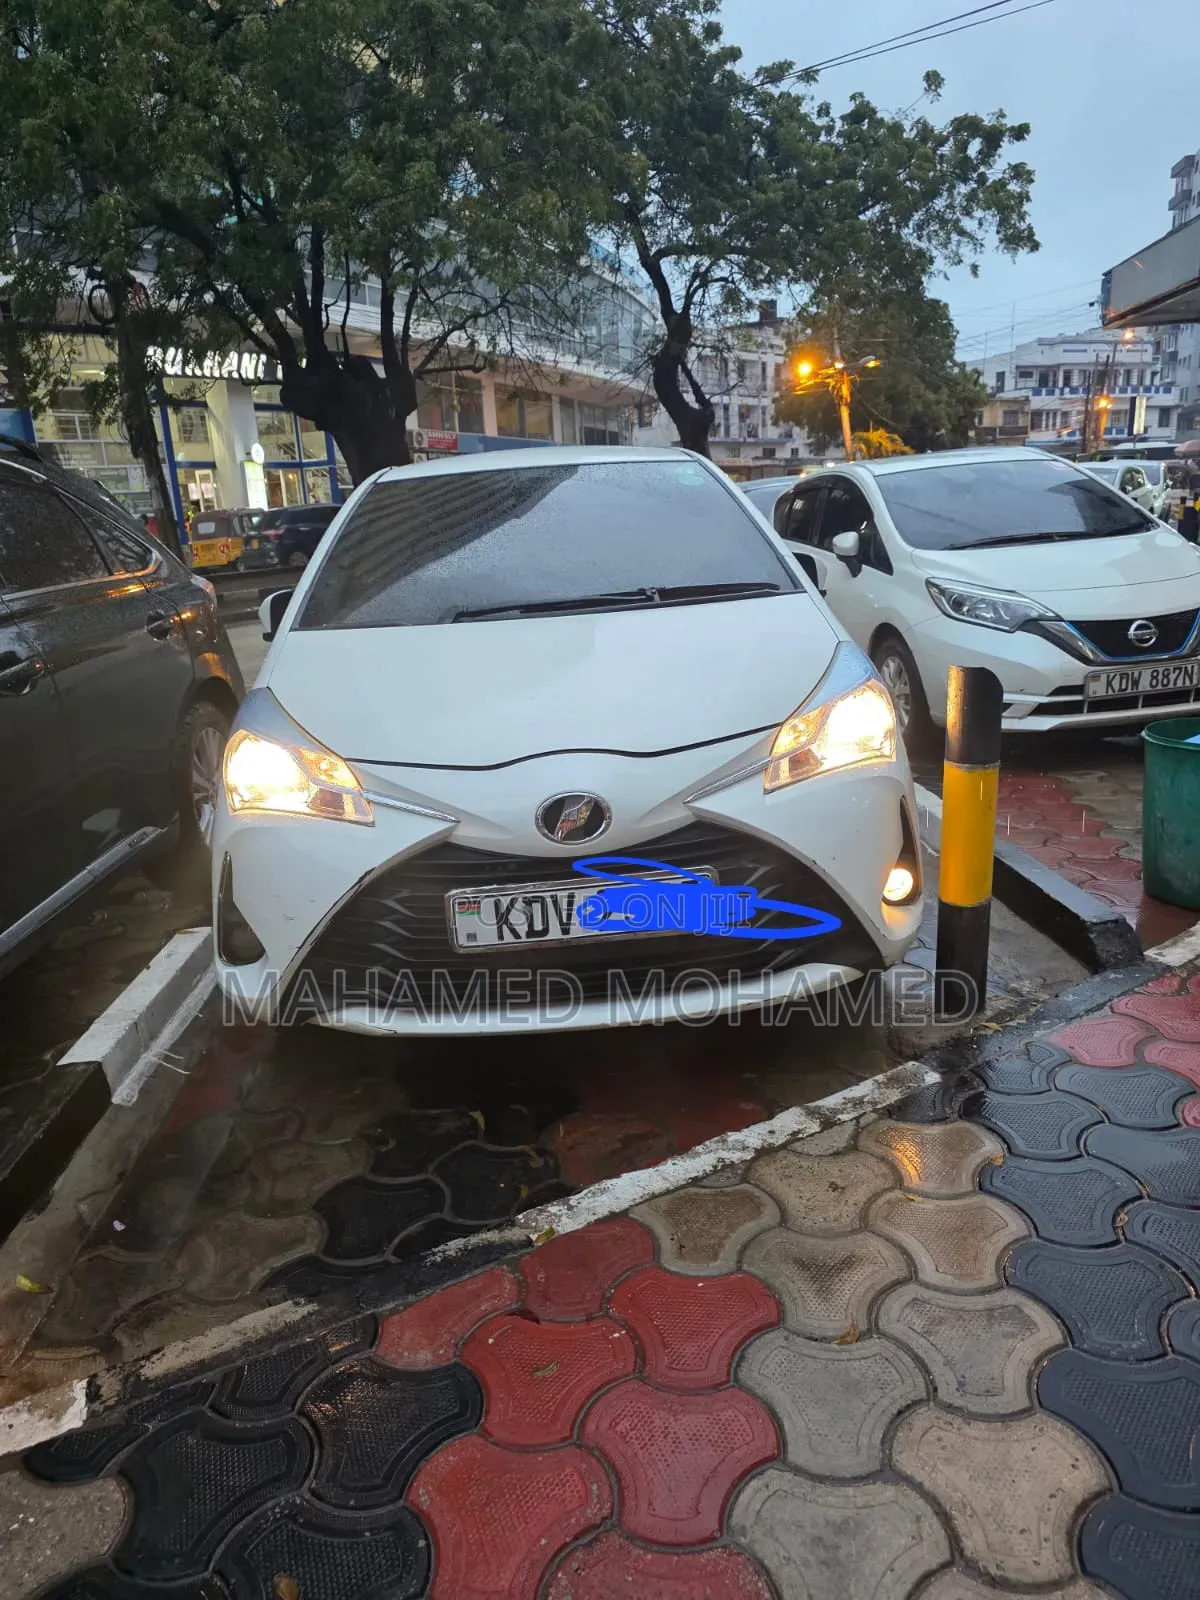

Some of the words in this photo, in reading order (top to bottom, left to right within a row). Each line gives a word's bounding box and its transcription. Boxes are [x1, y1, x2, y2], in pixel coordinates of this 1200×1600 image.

[1105, 670, 1142, 695] KDW
[1149, 664, 1195, 690] 887N
[493, 891, 576, 942] KDV
